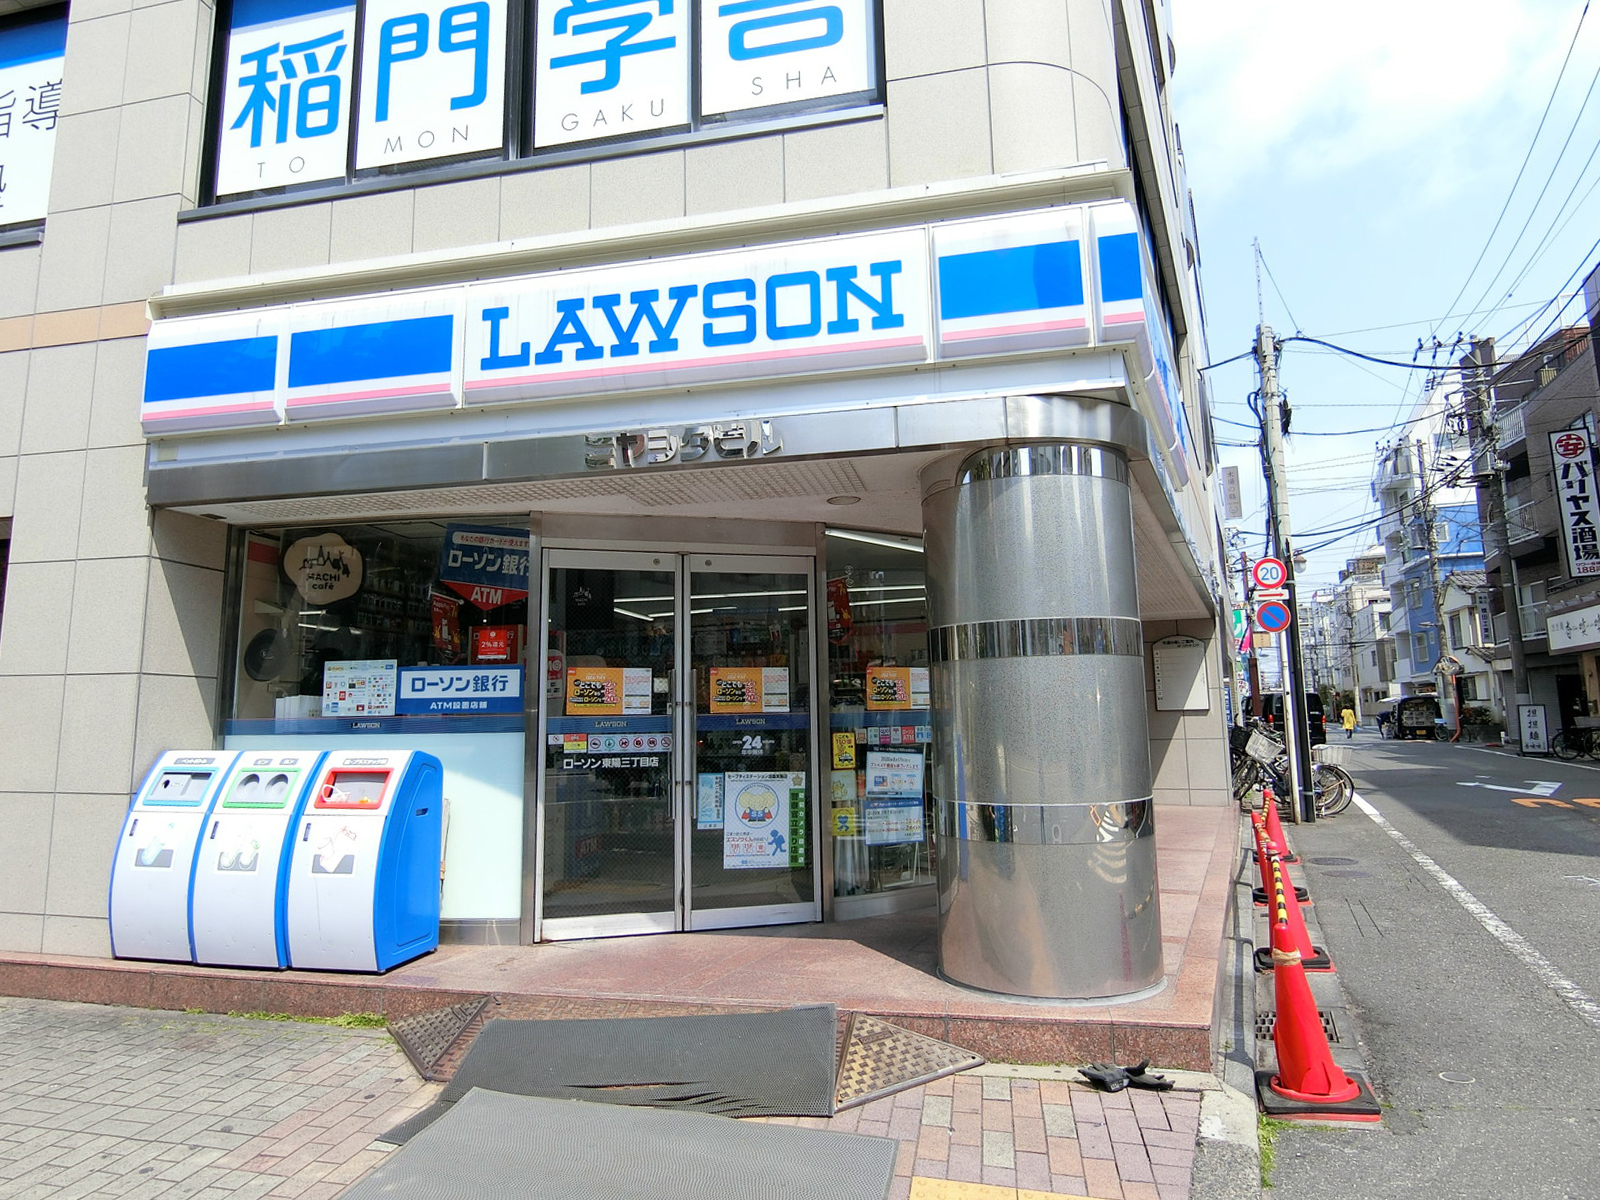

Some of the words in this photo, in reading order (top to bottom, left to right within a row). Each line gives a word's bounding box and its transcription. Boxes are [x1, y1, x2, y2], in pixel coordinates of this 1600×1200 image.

[257, 156, 306, 178] TO
[383, 125, 469, 155] MON
[562, 98, 665, 131] GAKU
[752, 66, 837, 96] SHA
[481, 260, 904, 371] LAWSON
[1561, 460, 1600, 561] バリヤス酒場
[307, 573, 341, 583] MACHI
[1260, 566, 1280, 581] 20
[312, 582, 334, 591] café
[470, 586, 503, 605] ATM
[411, 674, 509, 693] ローソン銀行
[429, 700, 488, 710] ATM設置店舗
[742, 735, 763, 749] 24
[563, 756, 659, 769] ローソン東陽三丁目店
